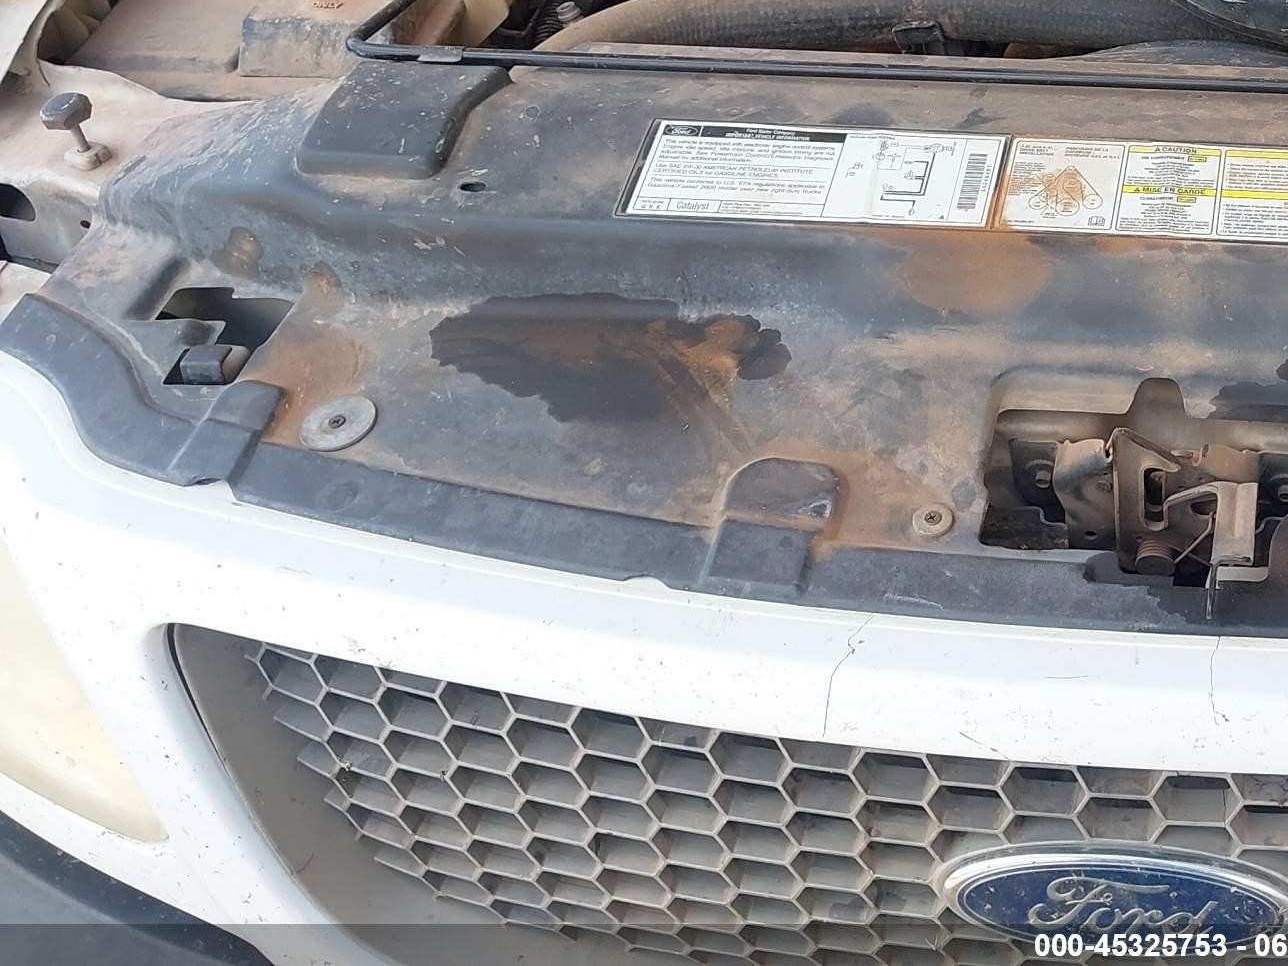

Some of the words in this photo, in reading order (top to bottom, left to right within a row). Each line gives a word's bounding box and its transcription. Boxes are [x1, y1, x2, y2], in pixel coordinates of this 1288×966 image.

[1162, 146, 1197, 154] CAUTION
[676, 201, 710, 211] Catalyst
[1028, 876, 1219, 936] Ford
